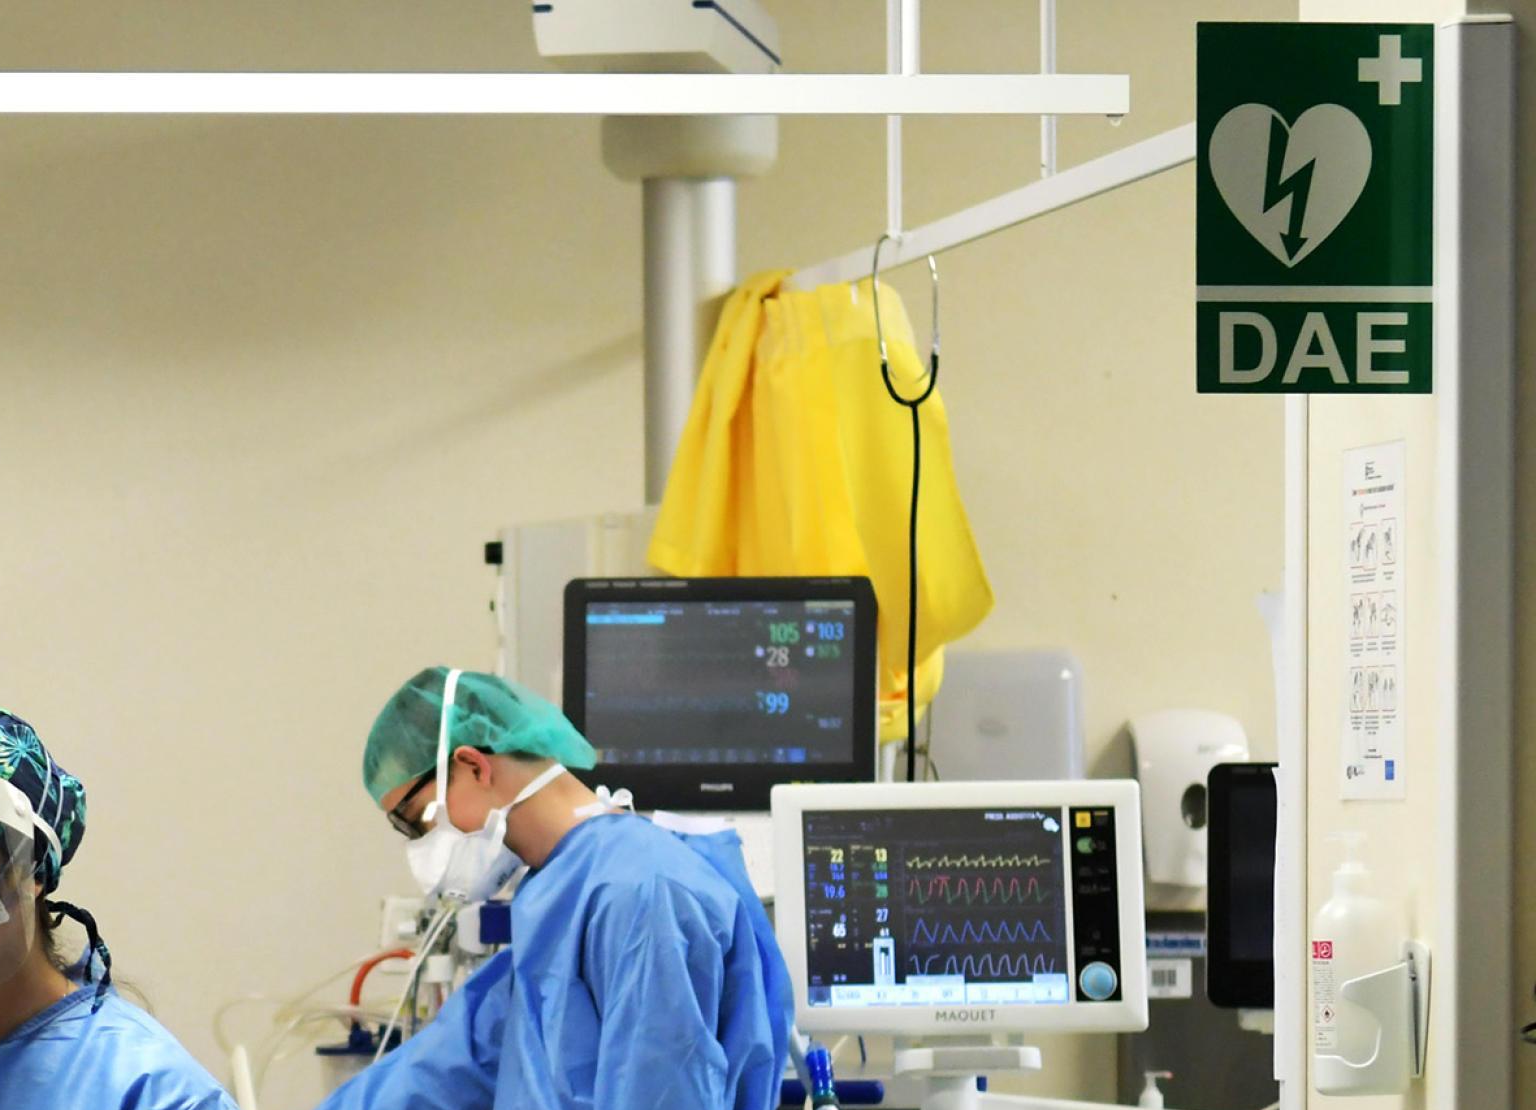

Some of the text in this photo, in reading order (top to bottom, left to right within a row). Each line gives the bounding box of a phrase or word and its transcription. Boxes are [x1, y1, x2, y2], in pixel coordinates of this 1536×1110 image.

[1219, 311, 1410, 384] DAE
[770, 622, 800, 644] 105
[818, 621, 844, 641] 103
[766, 646, 789, 667] 28
[766, 692, 789, 714] 99
[935, 1009, 996, 1022] MAQUET
